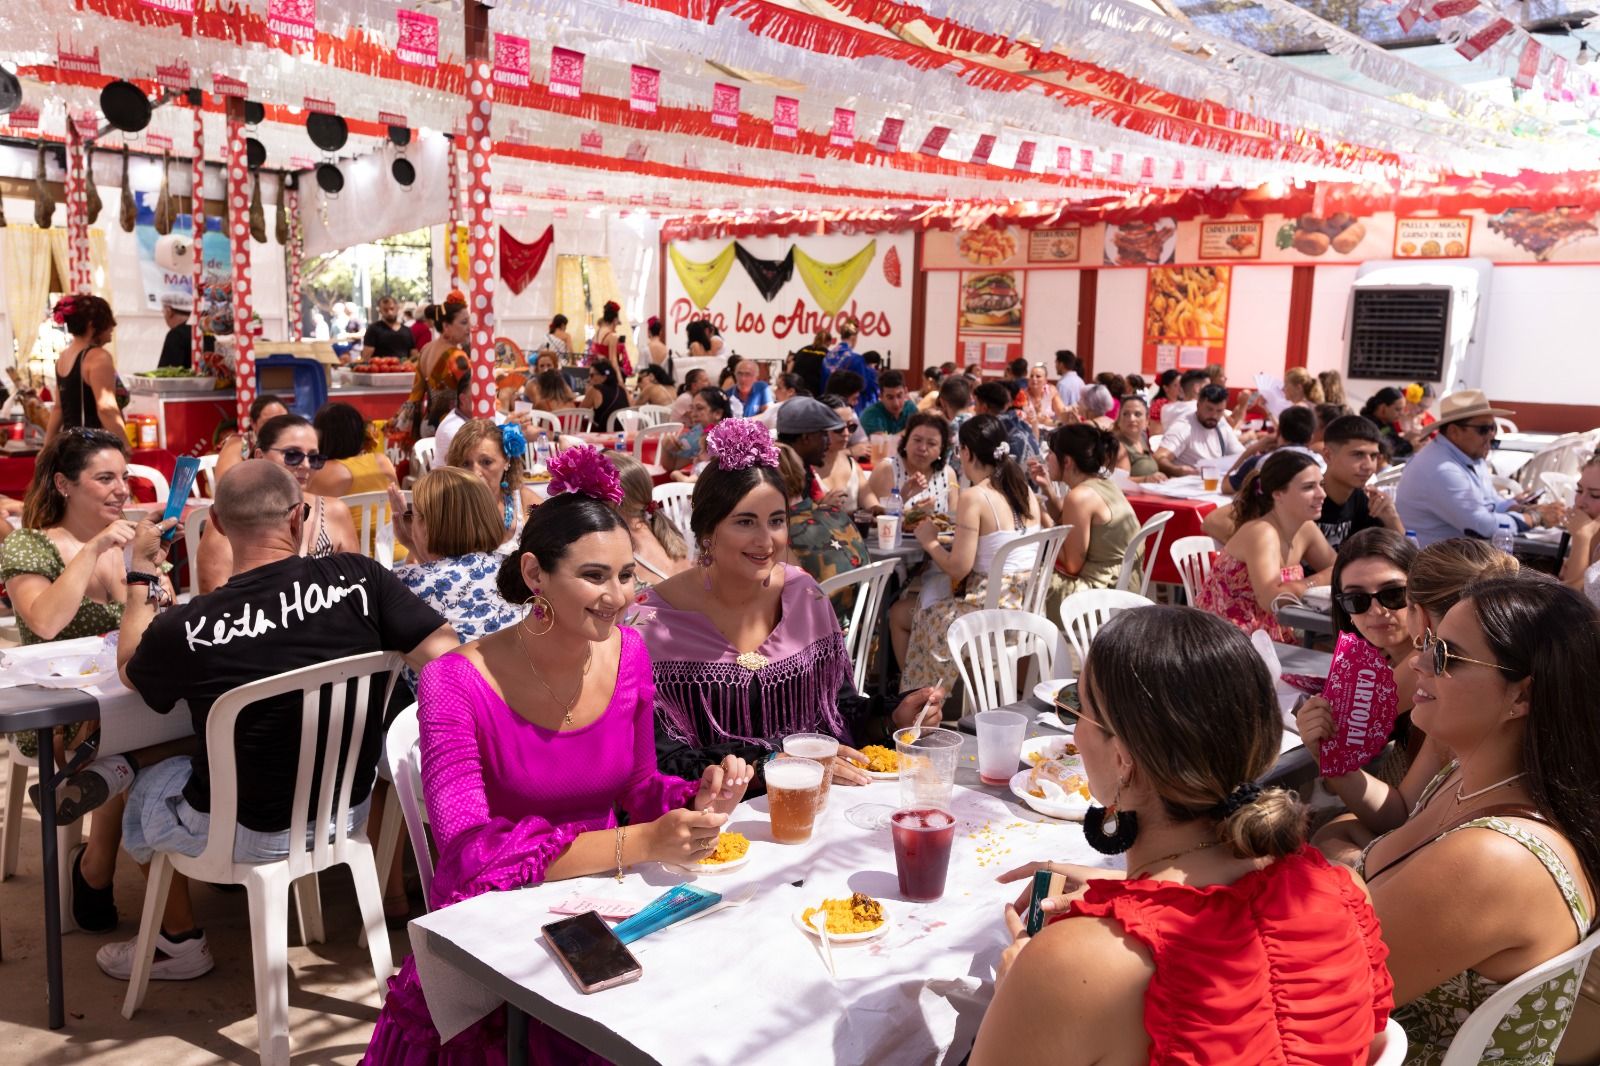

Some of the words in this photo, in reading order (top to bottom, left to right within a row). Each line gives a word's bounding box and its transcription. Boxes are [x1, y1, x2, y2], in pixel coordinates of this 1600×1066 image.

[270, 18, 315, 40] CARTOJAL
[60, 61, 100, 73] CARTOJAL
[397, 48, 437, 67] CARTOJAL
[493, 70, 529, 87] CARTOJAL
[550, 82, 581, 97] CARTOJAL
[736, 301, 766, 334] los
[185, 602, 276, 651] Keith
[279, 576, 369, 629] Haring
[1345, 668, 1377, 747] CARTOJAL
